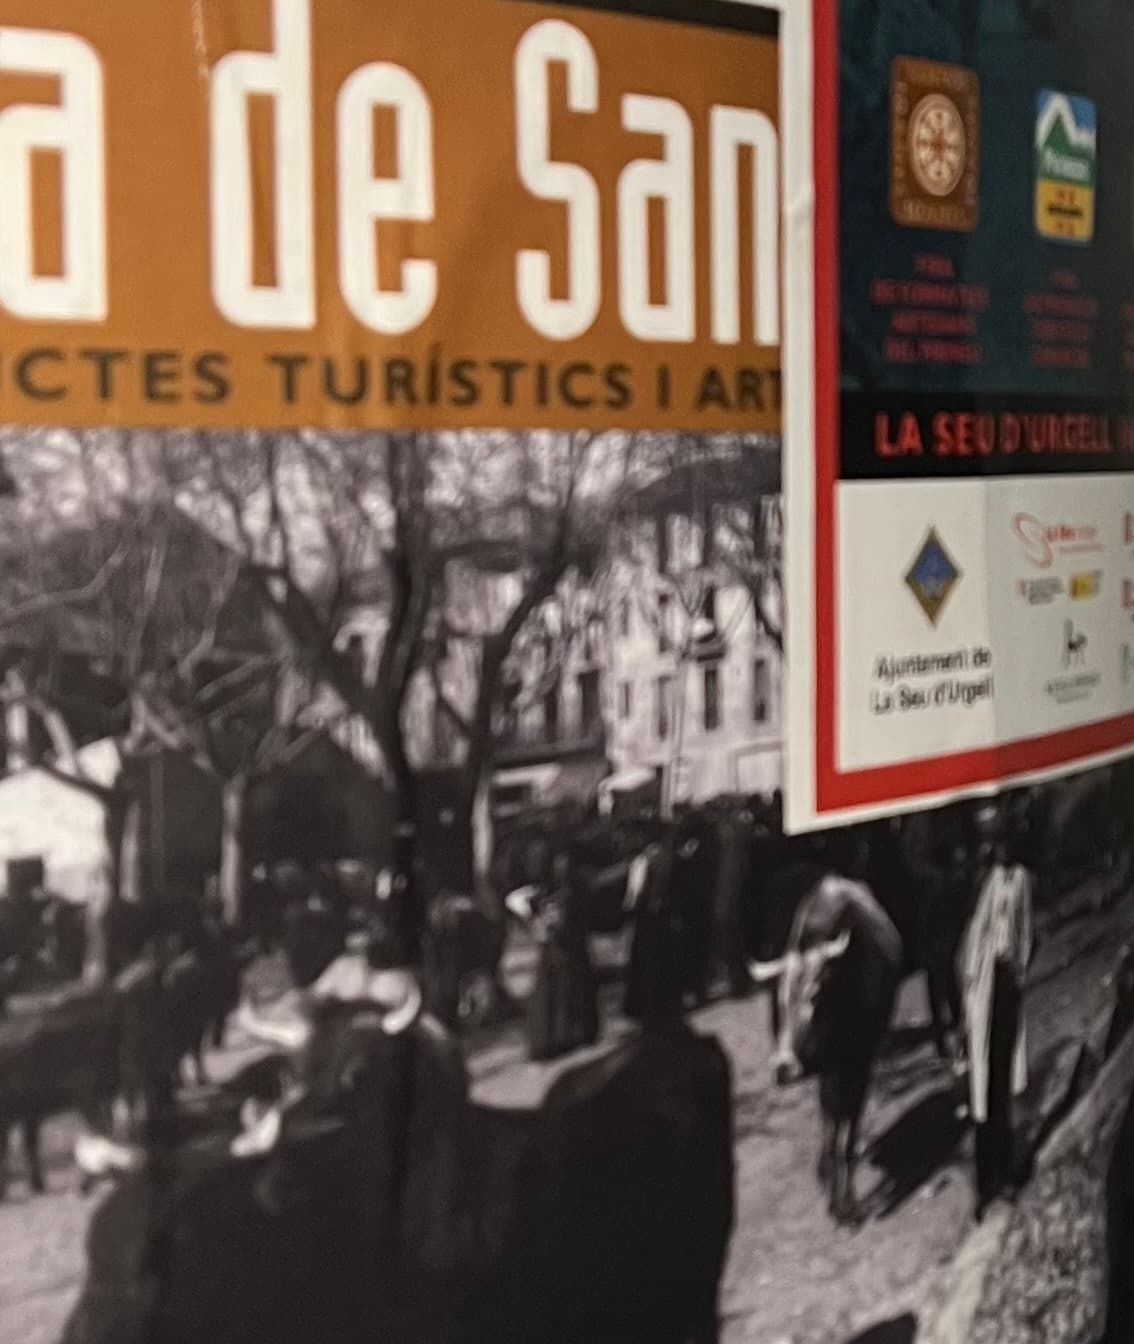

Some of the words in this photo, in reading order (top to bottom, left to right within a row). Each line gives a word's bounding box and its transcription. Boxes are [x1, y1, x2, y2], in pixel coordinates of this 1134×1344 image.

[514, 18, 779, 346] San
[14, 346, 232, 403] CTES
[271, 341, 632, 411] TURÍSTICS
[657, 364, 670, 411] I
[873, 409, 923, 459] LA
[933, 410, 997, 457] SEU
[898, 683, 931, 712] Seu
